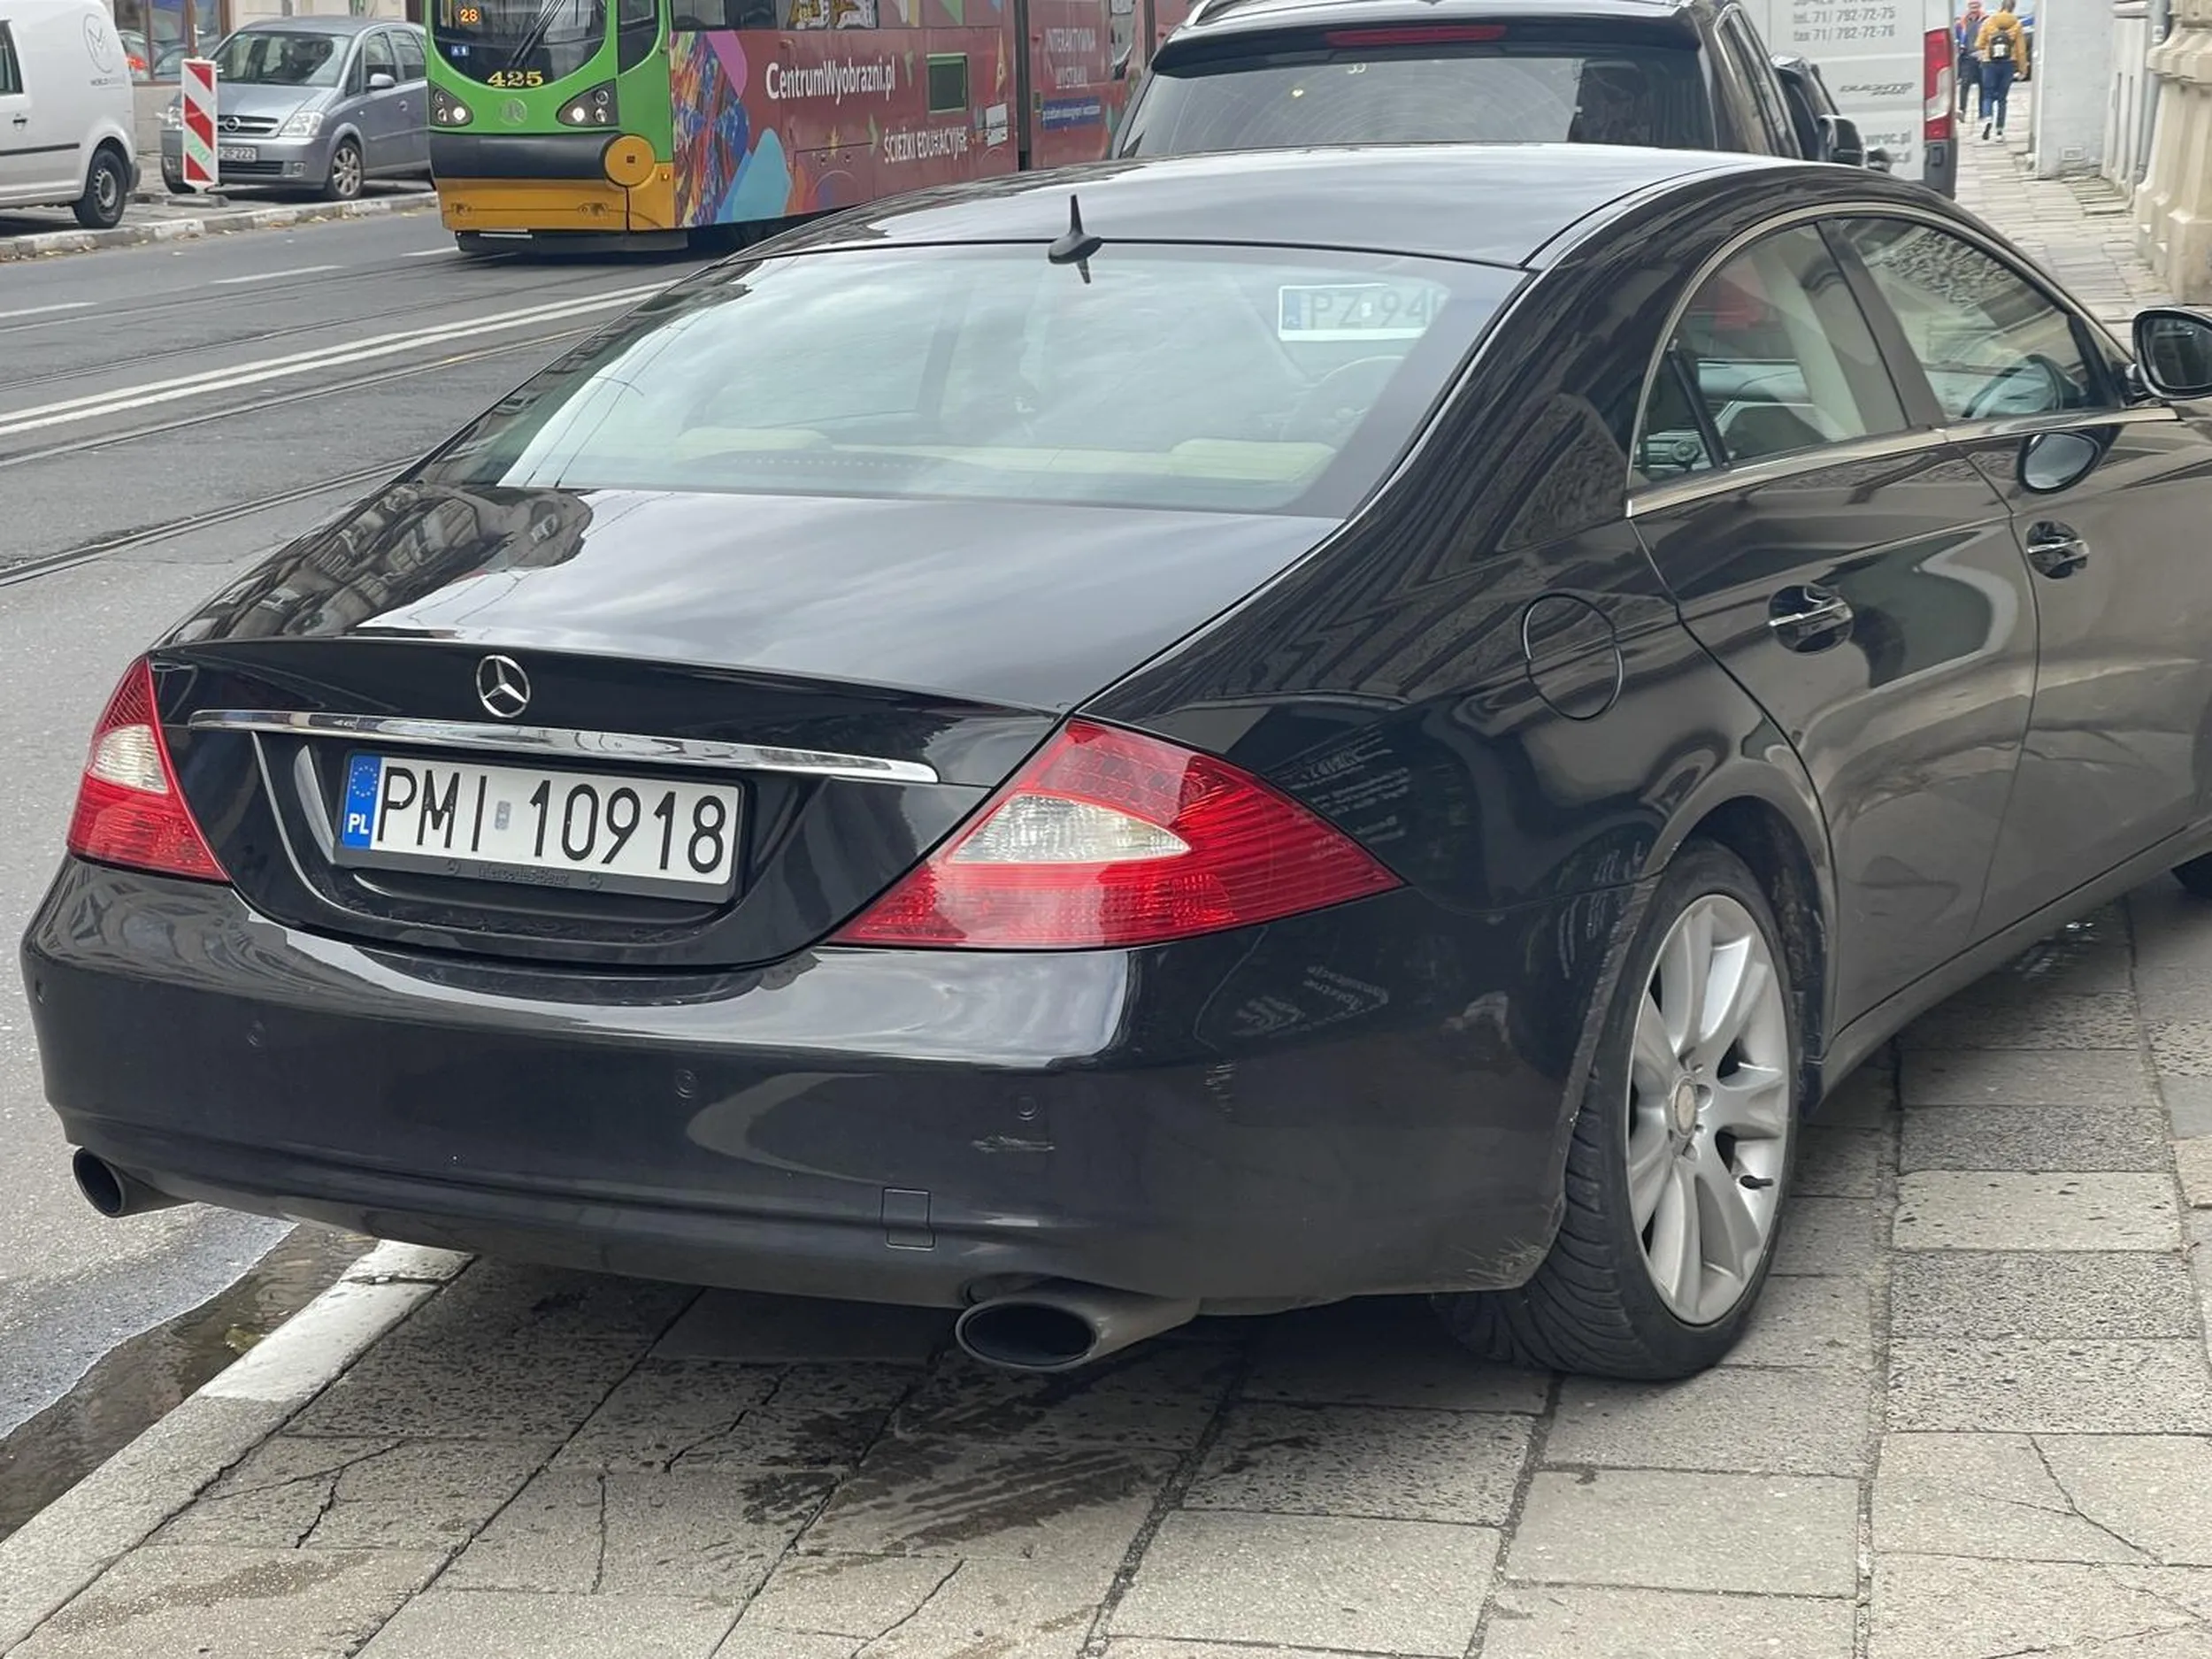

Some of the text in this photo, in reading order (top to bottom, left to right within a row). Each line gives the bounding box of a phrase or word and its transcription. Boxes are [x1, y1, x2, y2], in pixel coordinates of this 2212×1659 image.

[459, 8, 479, 22] 28
[487, 71, 543, 88] 425
[766, 55, 895, 105] CentrumWyobrazni.pl
[1309, 290, 1364, 330] PZ
[347, 812, 370, 835] PL
[376, 765, 727, 874] PMI 10918
